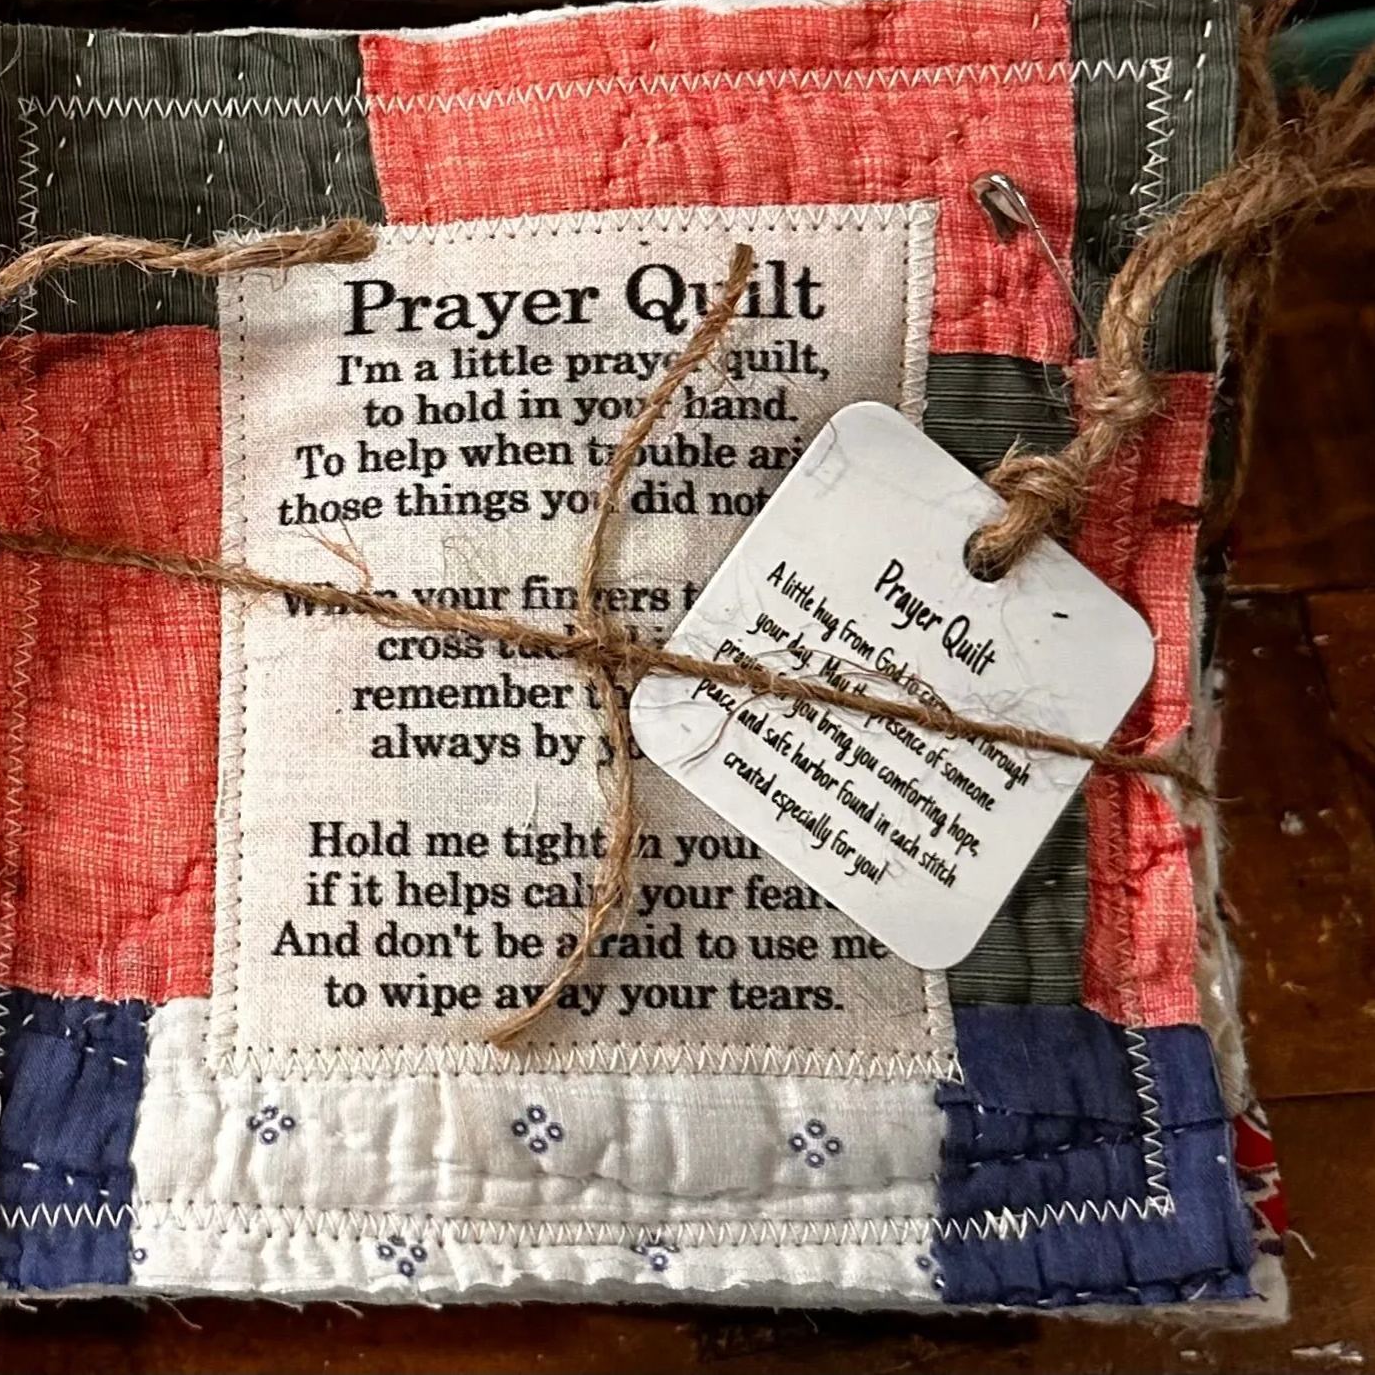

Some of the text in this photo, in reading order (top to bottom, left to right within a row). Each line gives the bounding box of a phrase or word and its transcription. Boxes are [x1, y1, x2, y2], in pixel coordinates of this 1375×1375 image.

[342, 277, 601, 341] Prayer
[335, 340, 830, 387] I'm a little pray quilt,
[874, 558, 995, 675] Prayer Quilt
[723, 752, 889, 884] created especially for you!
[737, 698, 769, 734] and
[762, 727, 792, 756] safe
[790, 742, 839, 790] harbor
[836, 779, 879, 823] found
[873, 813, 890, 836] in
[889, 829, 920, 858] each
[918, 851, 956, 887] stitch
[306, 874, 343, 907] if
[350, 875, 382, 907] it
[396, 873, 512, 913] helps
[524, 872, 623, 909] cal
[637, 878, 735, 914] your
[272, 920, 888, 961] And don't be araid to use me
[325, 974, 367, 1009] to
[379, 975, 482, 1017] wipe
[618, 978, 719, 1018] your
[729, 978, 844, 1011] tears.
